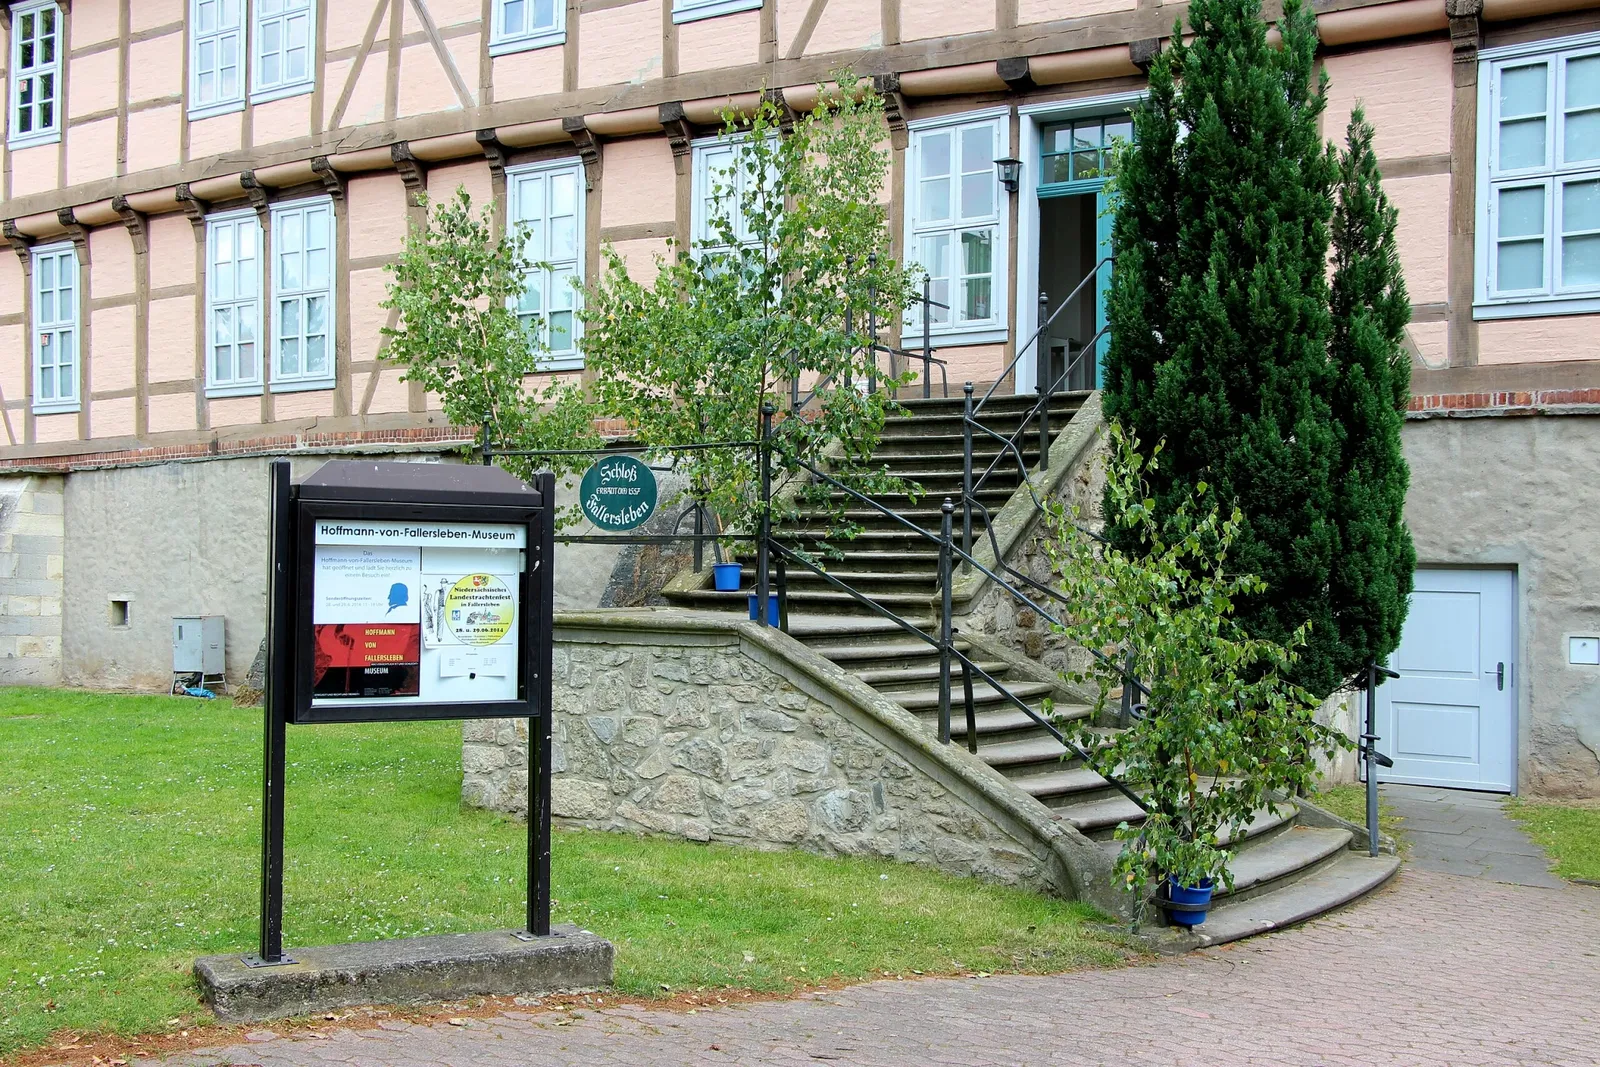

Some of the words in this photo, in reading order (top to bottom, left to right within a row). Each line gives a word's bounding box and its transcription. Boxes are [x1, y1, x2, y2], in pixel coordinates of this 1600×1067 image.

[600, 461, 638, 485] Schloß
[586, 493, 650, 526] Fallersleben
[320, 525, 516, 541] Hoffmann-von-Fallersleben-Museum
[364, 628, 396, 636] HOFFMANN
[364, 667, 389, 675] MUSEUM
